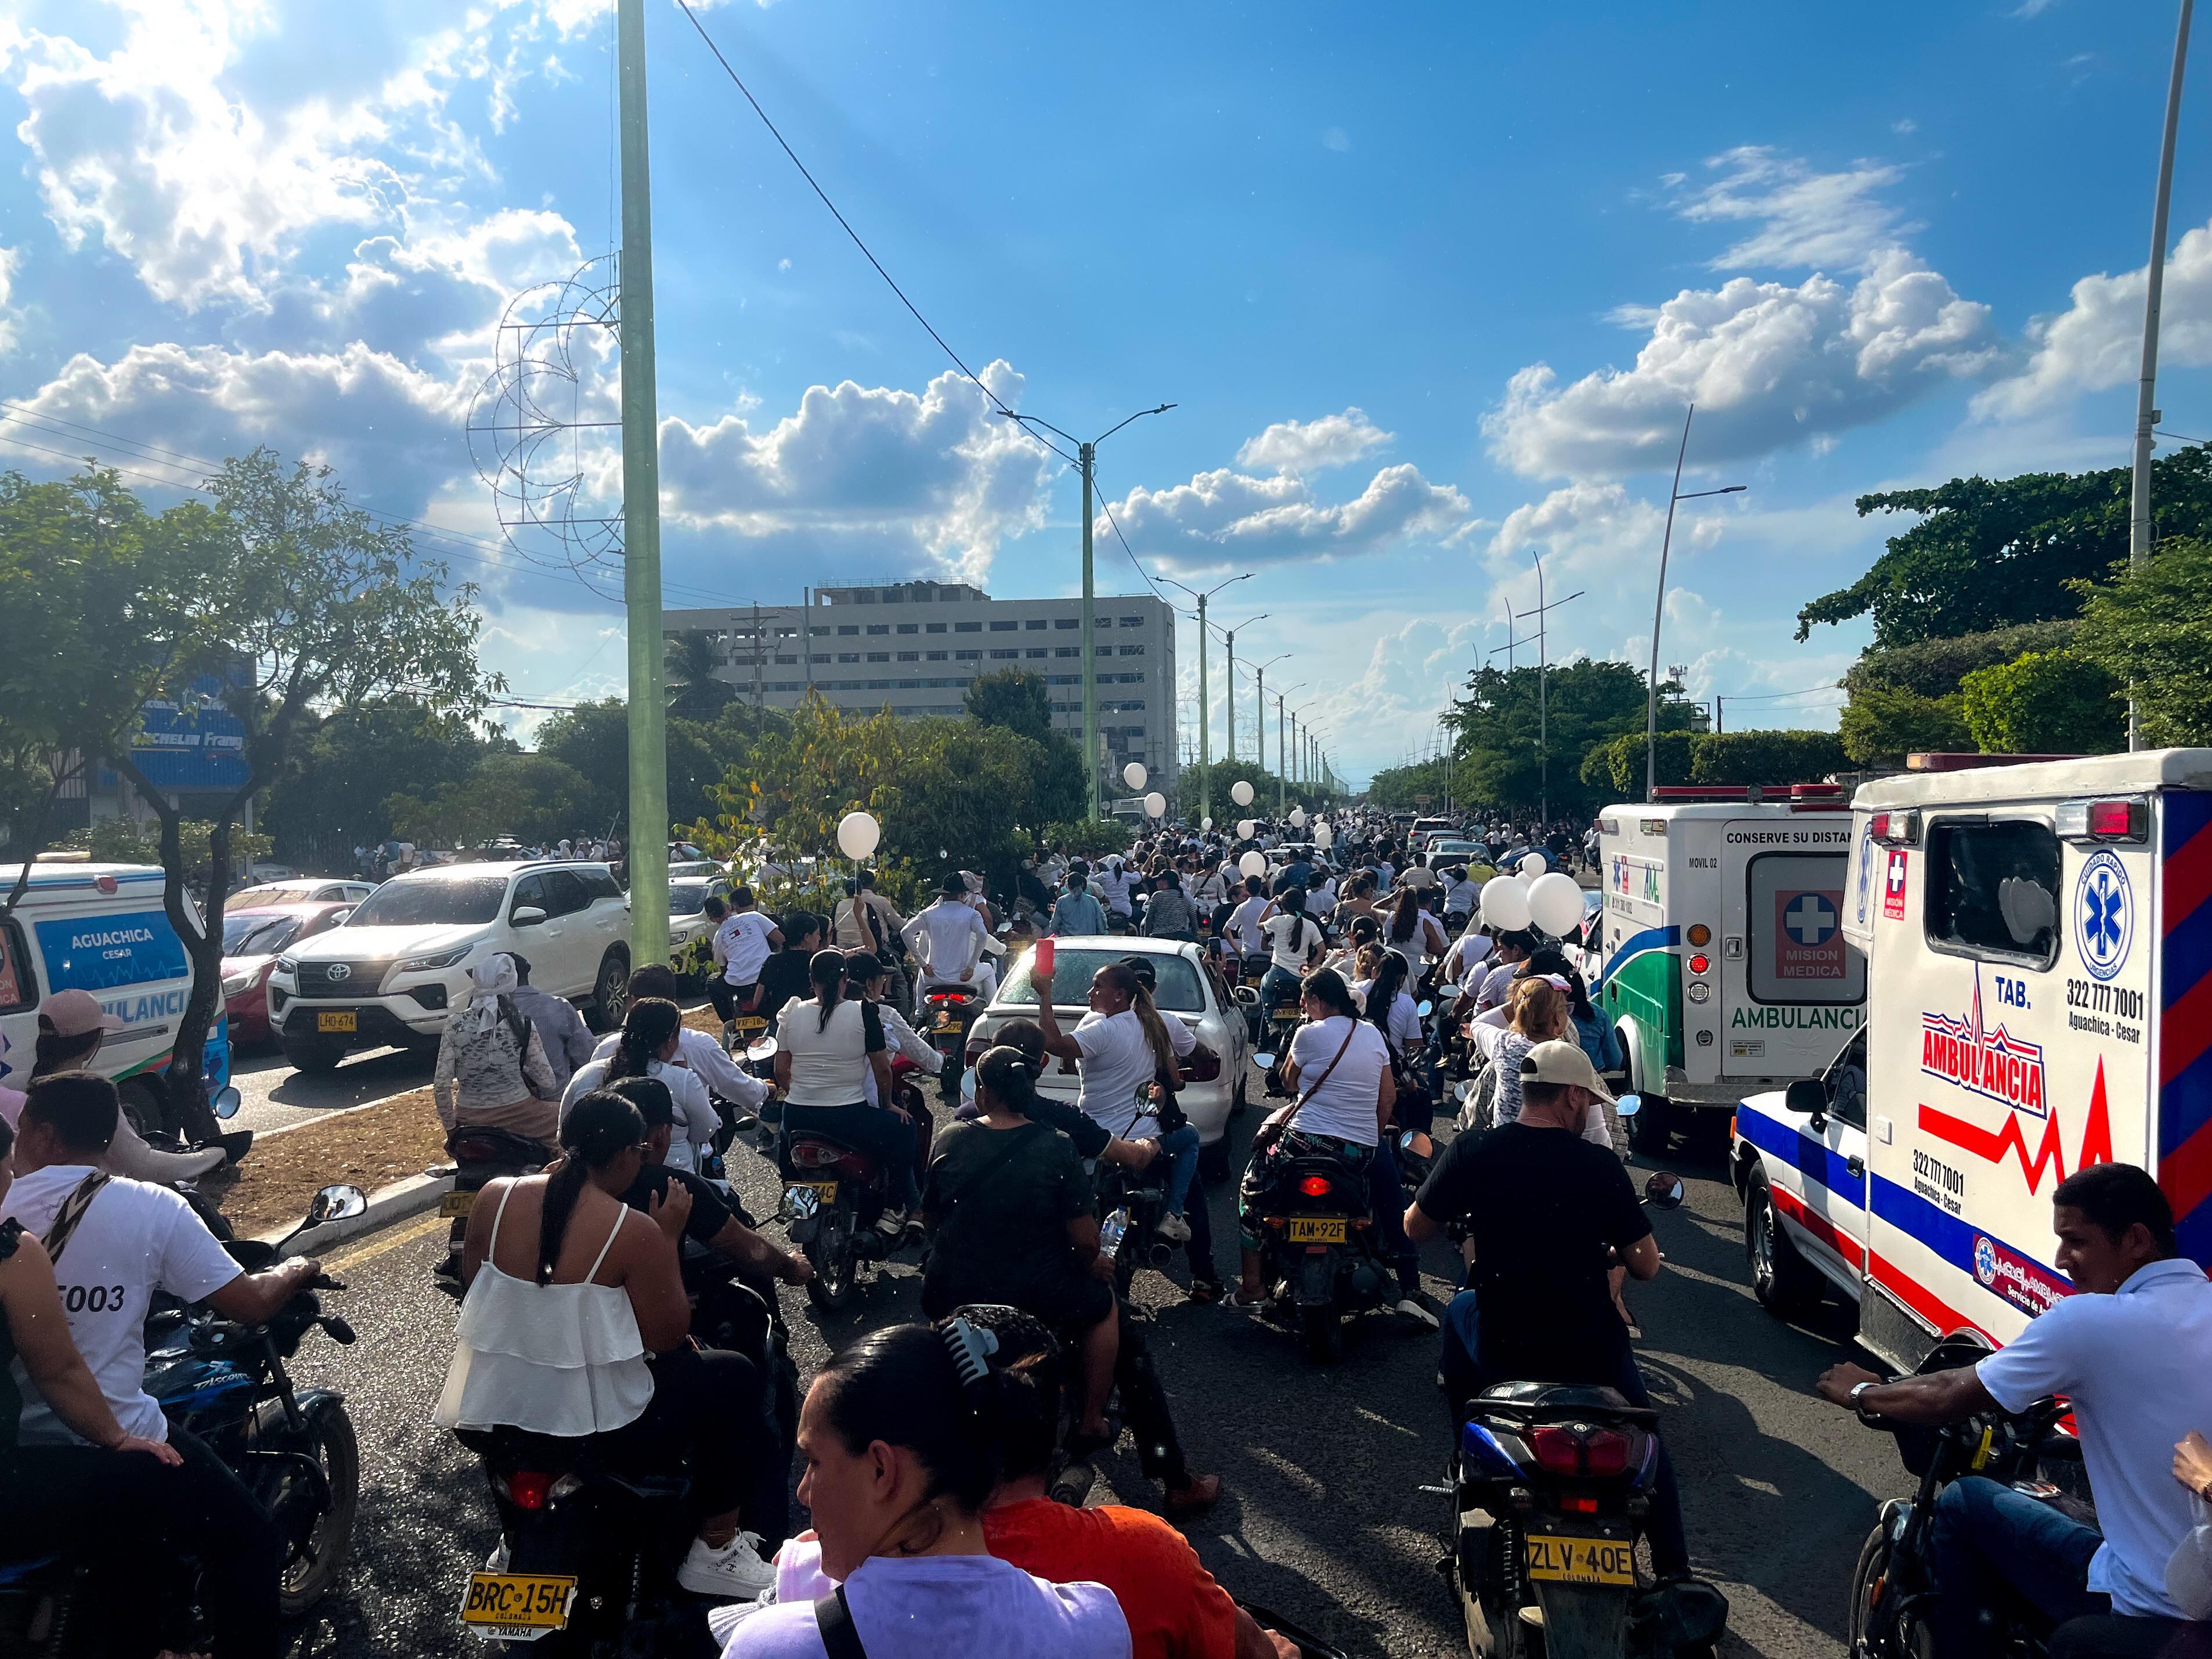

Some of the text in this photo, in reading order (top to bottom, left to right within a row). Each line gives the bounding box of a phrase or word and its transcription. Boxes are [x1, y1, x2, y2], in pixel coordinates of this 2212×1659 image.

[1727, 832, 1852, 843] CONSERVE SU DISTAN
[1689, 857, 1717, 868] MOVIL 02
[2081, 854, 2126, 885] CUIDADO RAPIDO
[72, 928, 154, 950] AGUACHICA
[102, 948, 132, 960] CESAR
[1786, 950, 1838, 961] MISION
[1783, 965, 1842, 976] MEDICA
[2089, 961, 2117, 977] URGENCIAS
[1995, 976, 2031, 1010] TAB.
[2067, 979, 2144, 1020] 322 777 7001
[1731, 1007, 1867, 1030] AMBULANCI
[2069, 1011, 2110, 1037] Aguachica
[2116, 1022, 2141, 1044] Cesar
[1922, 1030, 2042, 1109] AMBULANCIA
[1913, 1149, 1964, 1197] 322 777 7001
[1914, 1176, 1940, 1204] Aguachica
[1944, 1193, 1961, 1216] Cesar
[2007, 1284, 2030, 1307] Servicio
[2031, 1299, 2038, 1312] de
[495, 1612, 531, 1621] COLOMBIA
[498, 1626, 533, 1638] YAMAHA
